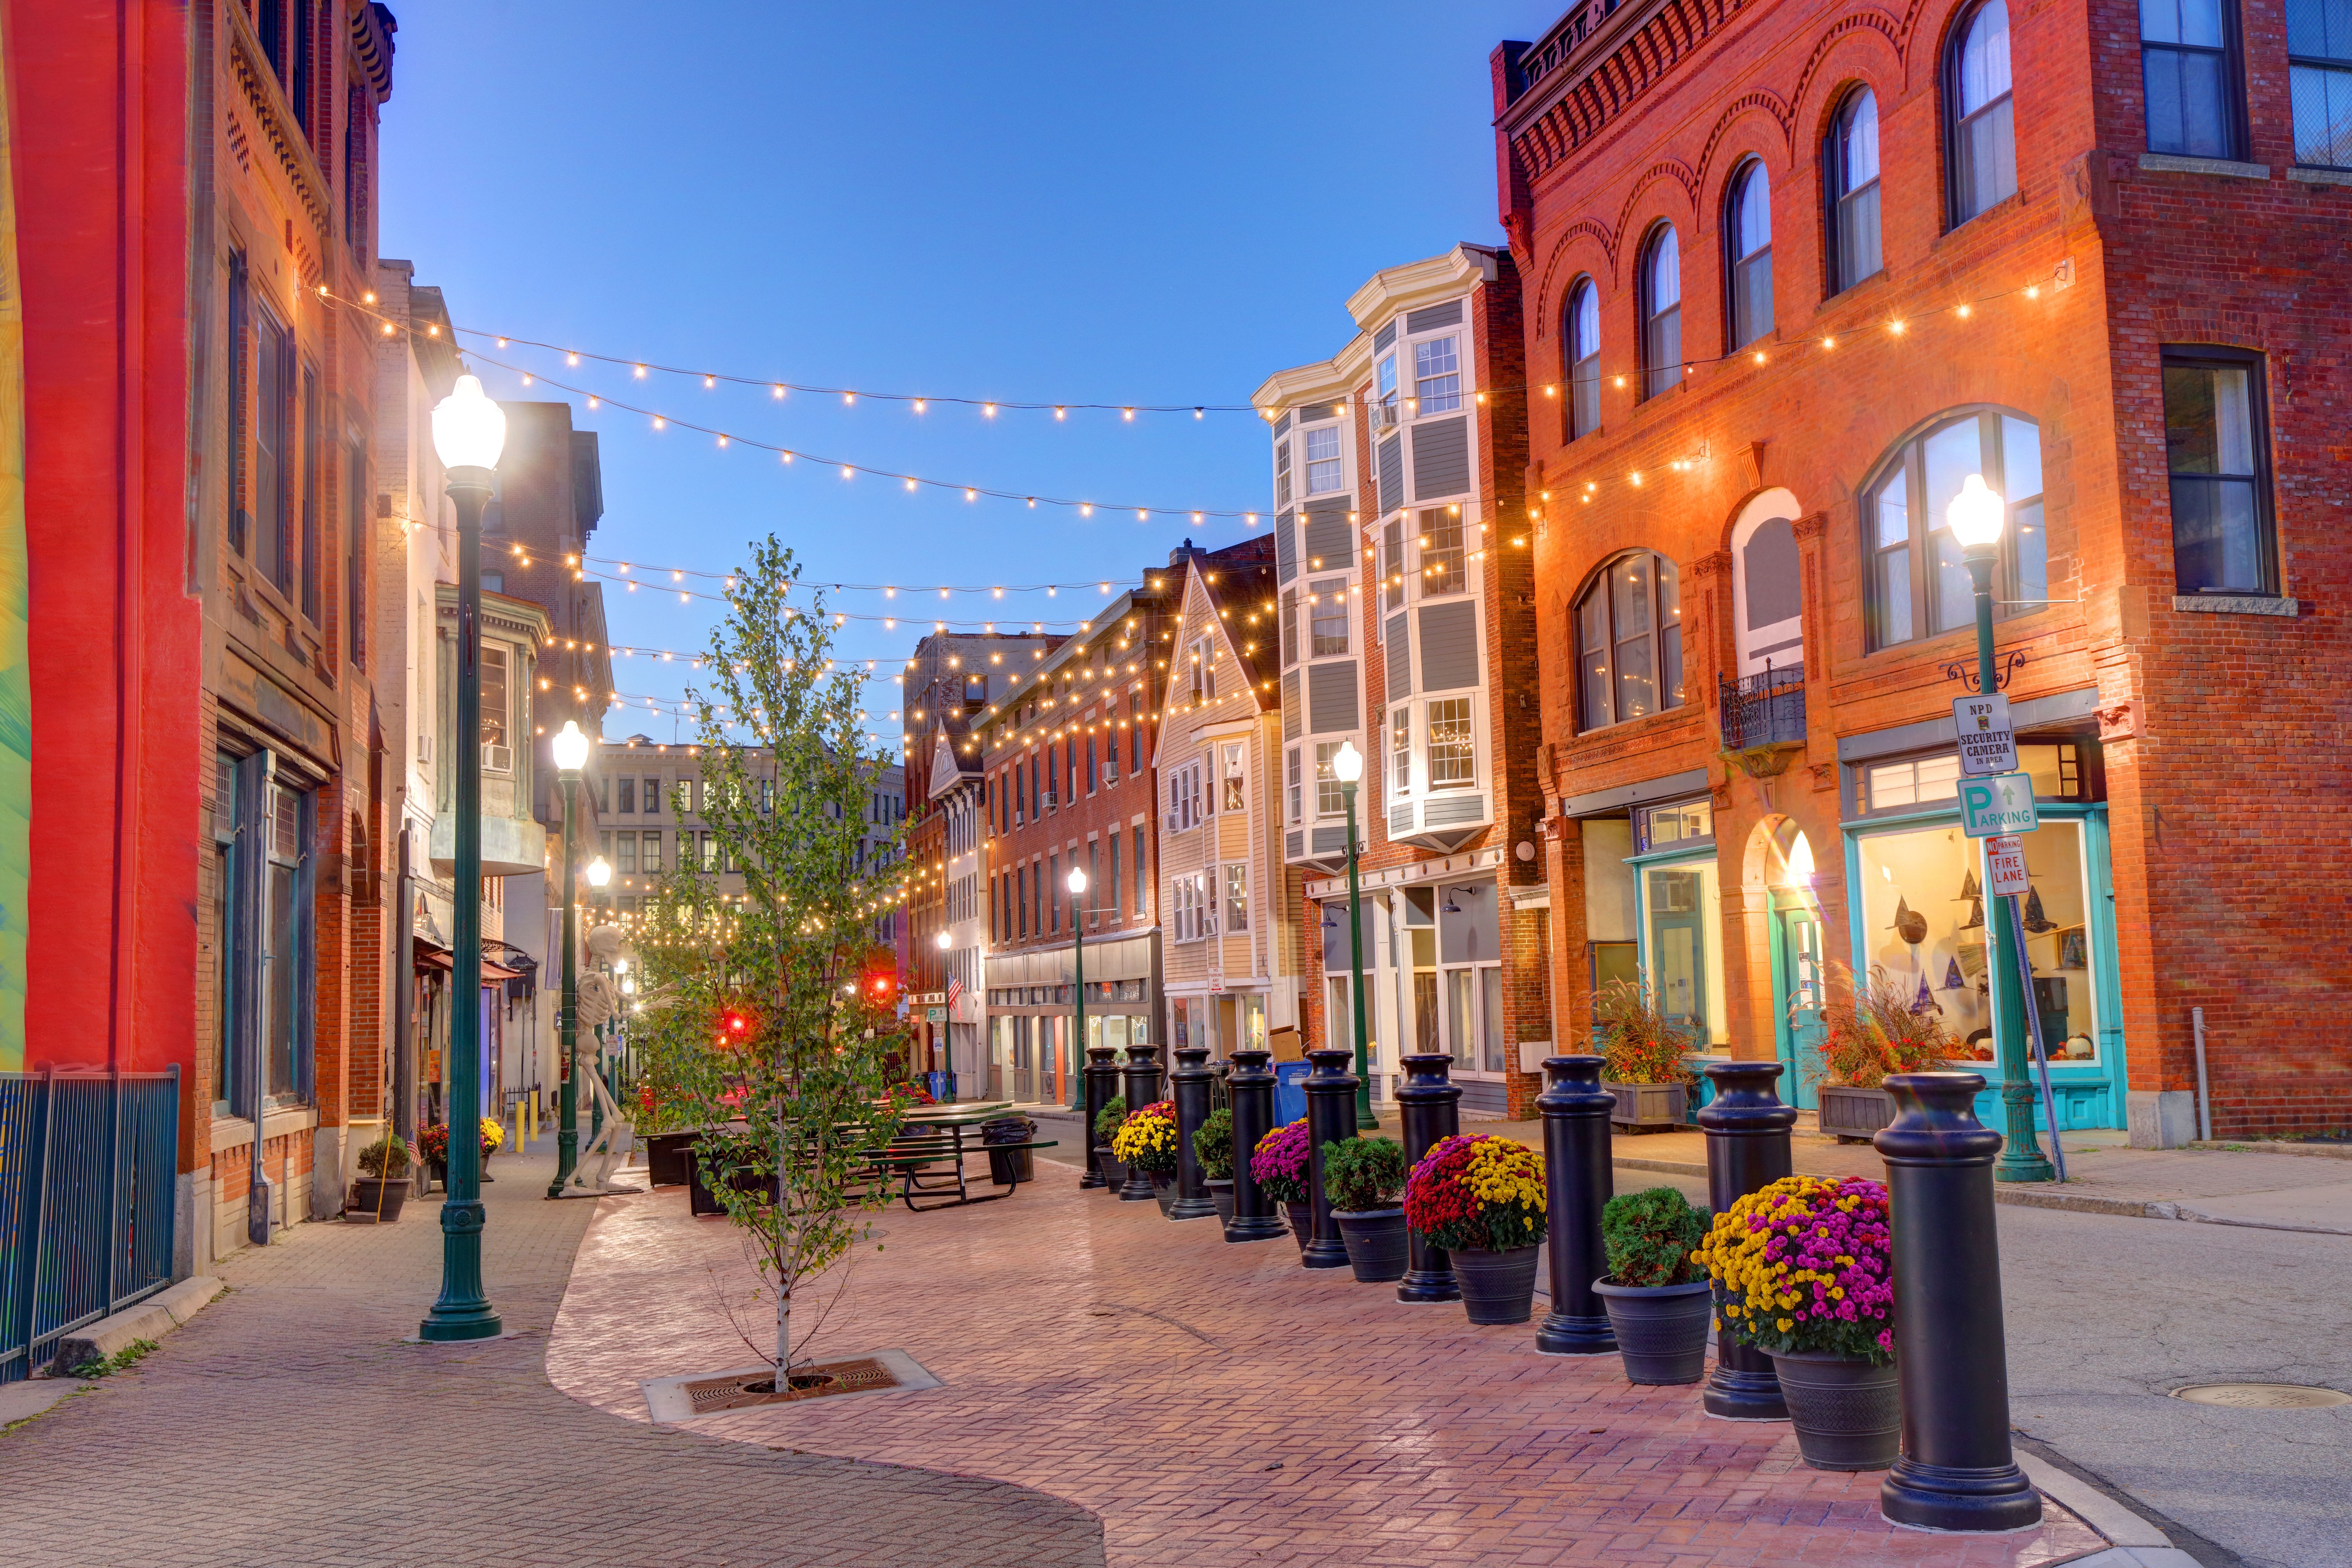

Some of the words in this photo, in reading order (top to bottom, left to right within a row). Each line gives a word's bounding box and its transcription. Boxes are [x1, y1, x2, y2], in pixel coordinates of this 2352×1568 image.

[1969, 704, 1993, 715] NPD
[1961, 731, 2010, 745] SECURITY
[1967, 743, 2010, 756] CAMERA
[1986, 756, 2004, 764] AREA
[1964, 786, 2030, 828] PARKING
[1986, 841, 1998, 852] NO
[1998, 840, 2021, 850] PARKING
[1995, 856, 2019, 870] FIRE
[1995, 870, 2024, 883] LANE
[930, 1010, 946, 1020] PARKING
